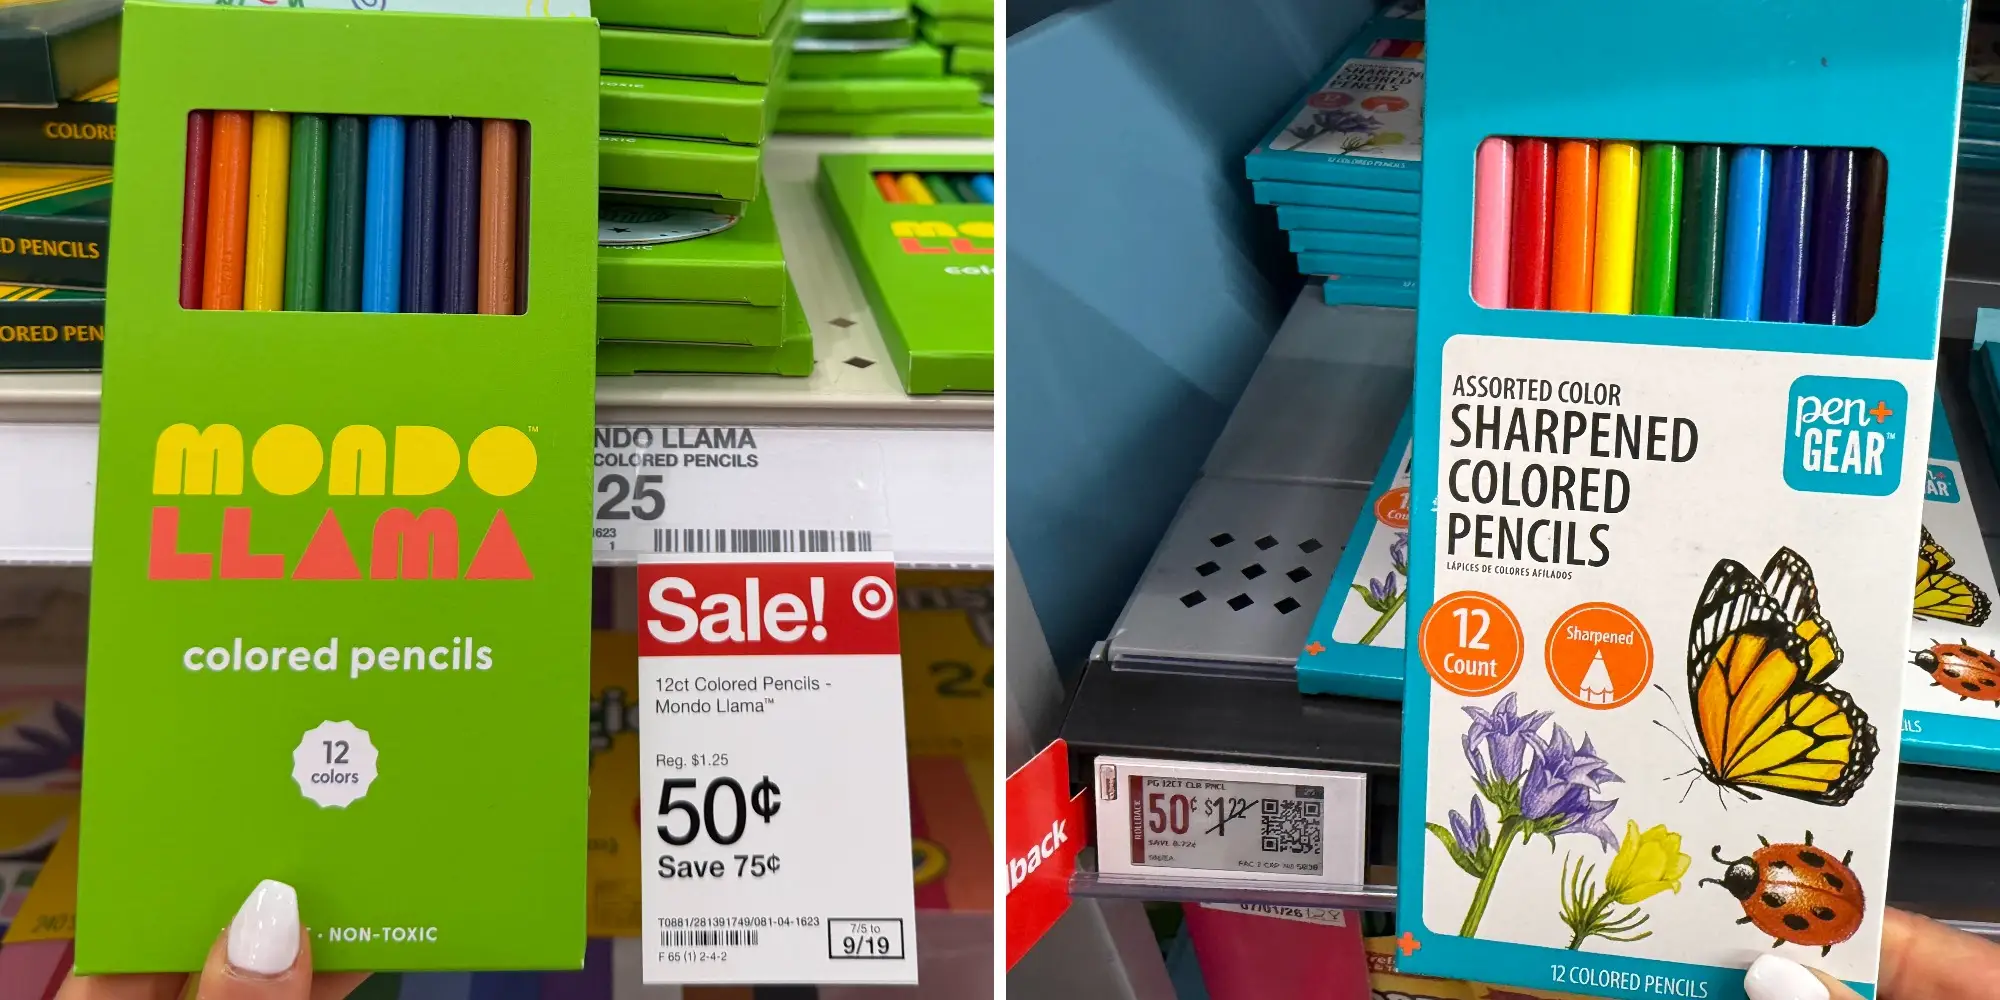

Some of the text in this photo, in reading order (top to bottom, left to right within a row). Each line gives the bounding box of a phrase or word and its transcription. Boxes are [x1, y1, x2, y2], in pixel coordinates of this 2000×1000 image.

[20, 238, 101, 259] PENCILS
[1452, 374, 1622, 406] ASSORTED COLOR
[662, 428, 757, 449] LLAMA
[1450, 404, 1698, 462] SHARPENED
[594, 453, 758, 468] COLORED PENCILS
[1448, 457, 1631, 514] COLORED
[149, 507, 534, 580] LLAMA
[1446, 512, 1611, 567] PENCILS
[1482, 564, 1492, 572] DE
[1494, 565, 1529, 576] COLORES
[646, 576, 828, 643] Sale!
[1452, 608, 1491, 650] 12
[1566, 625, 1634, 646] Sharpened
[183, 637, 494, 679] colored pencils
[1443, 653, 1498, 678] Count
[655, 677, 690, 692] 12ct
[694, 676, 757, 692] Colored
[763, 675, 820, 691] Pencils
[655, 699, 711, 714] Mondo
[322, 741, 350, 764] 12
[656, 753, 729, 769] Reg. $1.25
[311, 769, 359, 784] colors
[656, 775, 782, 846] 50¢
[657, 853, 781, 879] Save 75¢
[658, 916, 820, 928] T0881/281391749/081-04-1623
[850, 922, 881, 934] 7/5 to
[329, 927, 438, 943] NON-TOXIC
[843, 937, 889, 955] 9/19
[658, 952, 728, 963] F 65 (1) 2-4-2
[1551, 965, 1709, 999] 12 COLORED PENCILS
